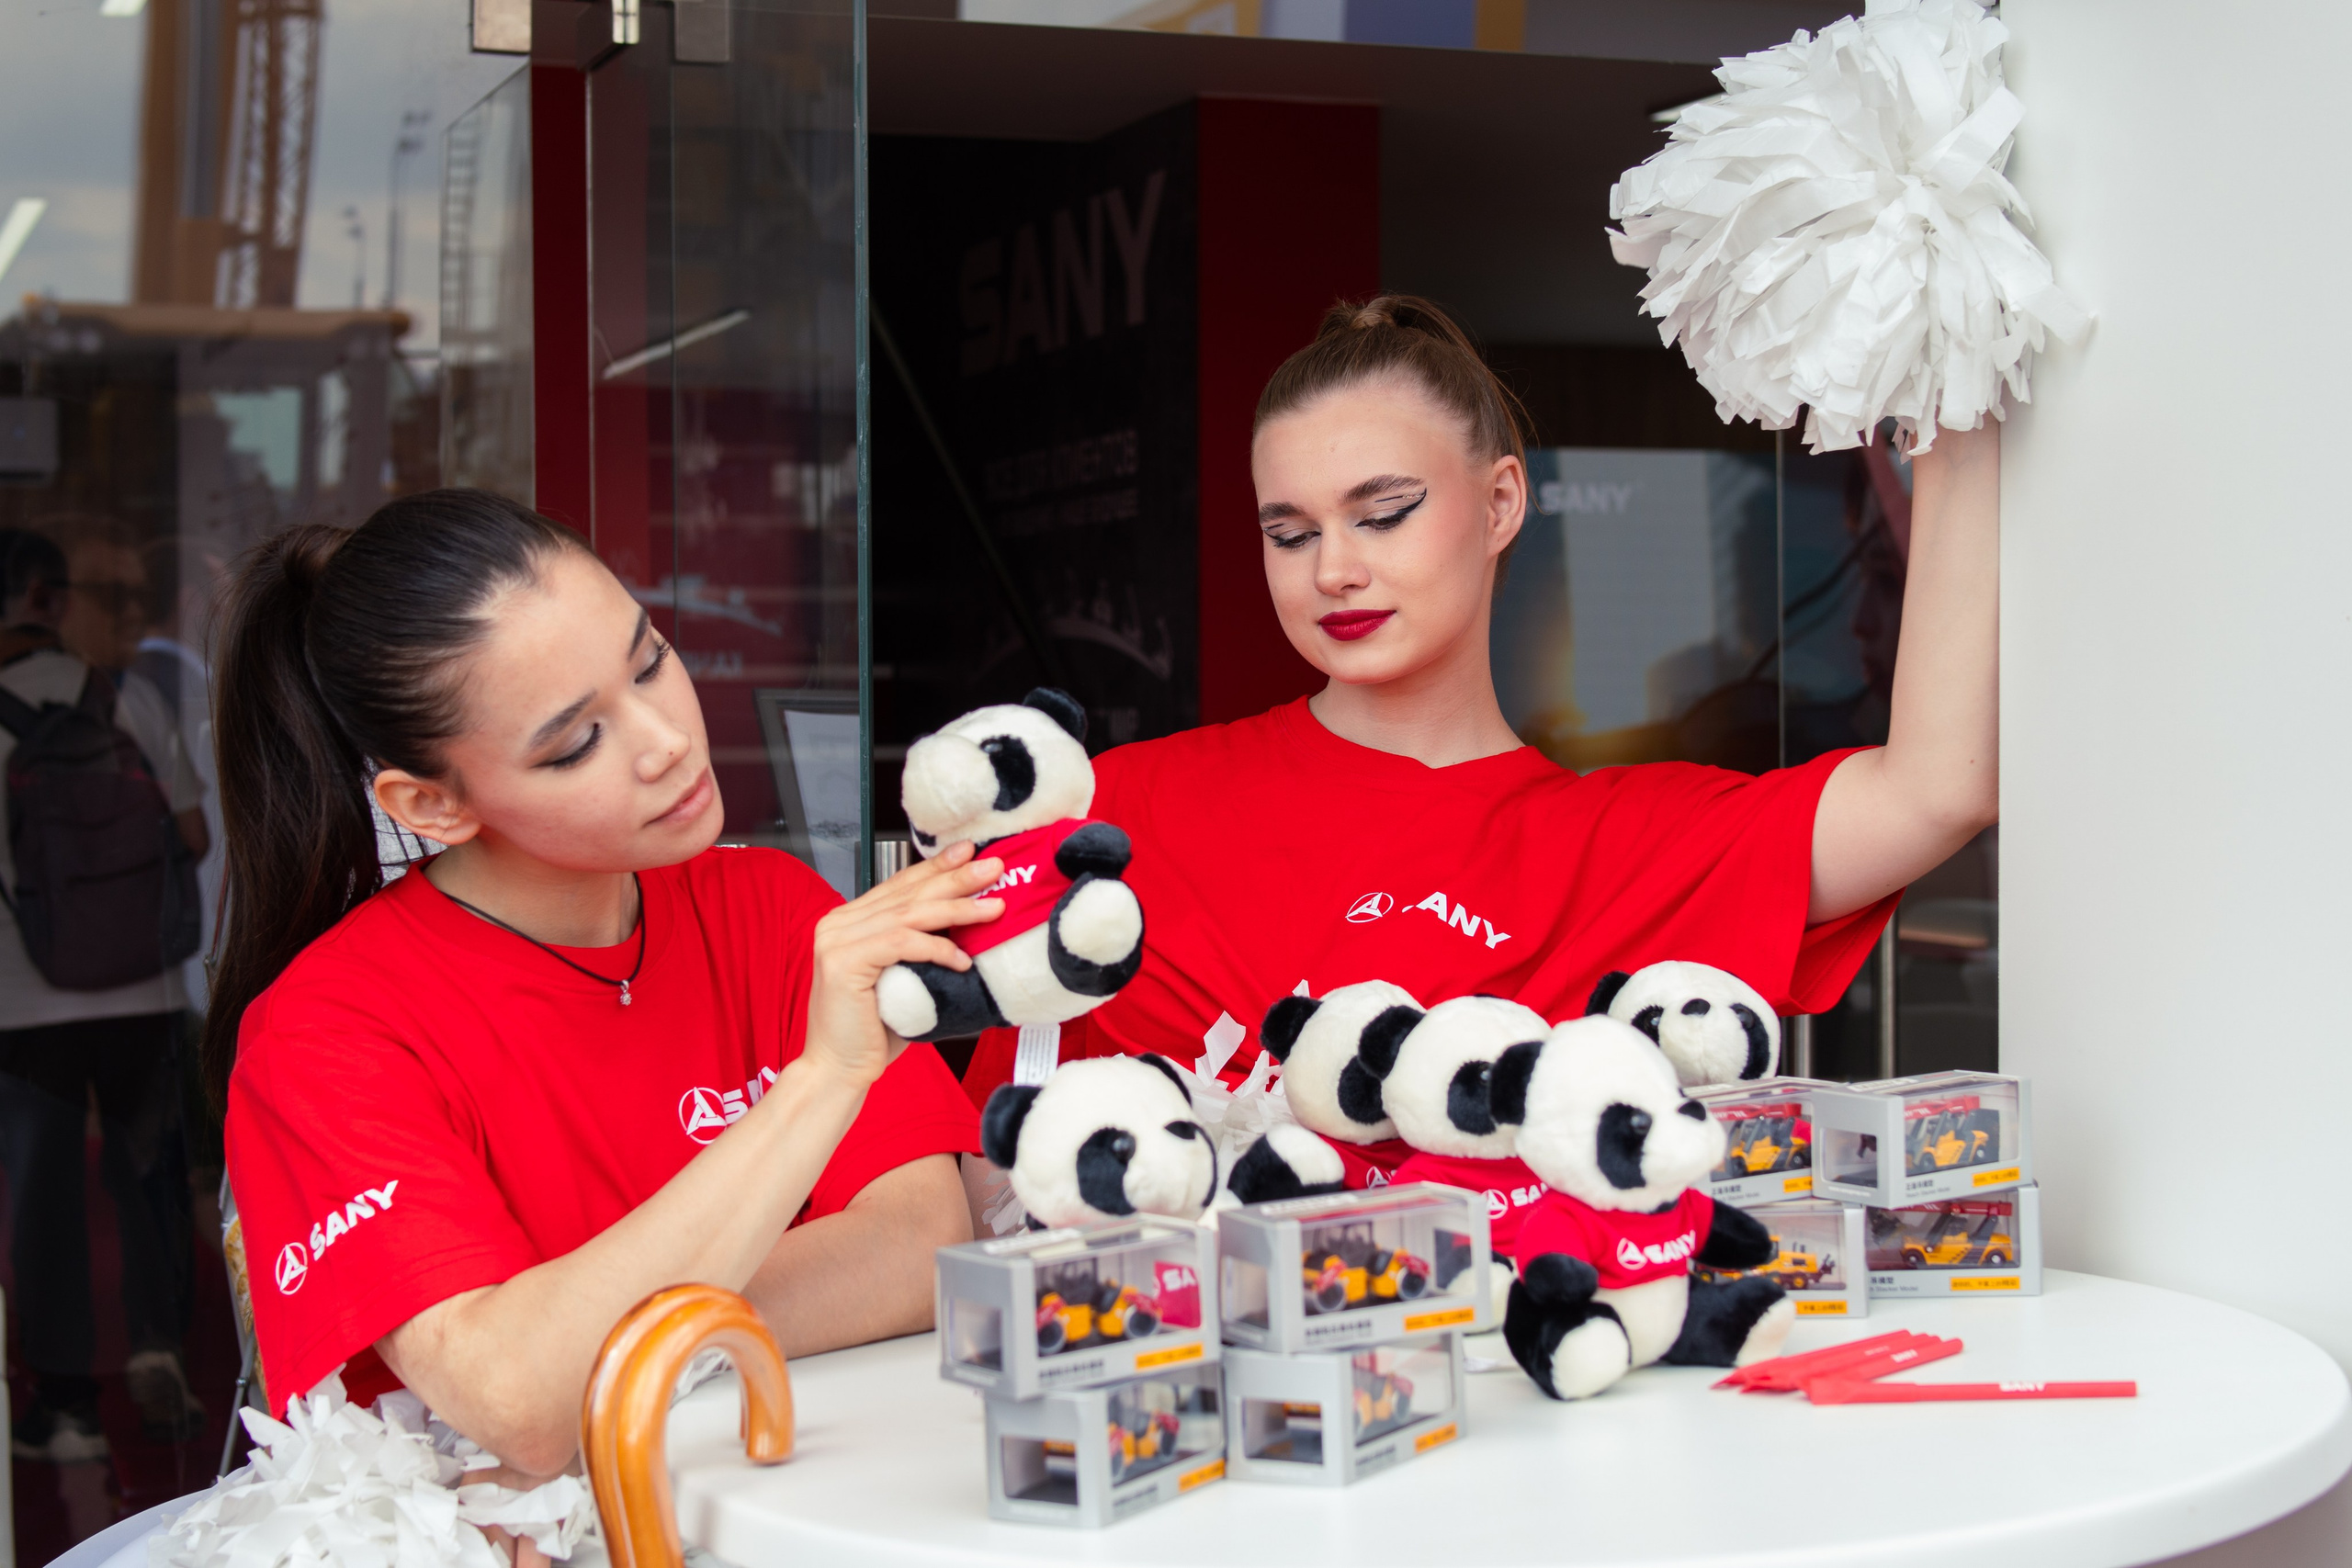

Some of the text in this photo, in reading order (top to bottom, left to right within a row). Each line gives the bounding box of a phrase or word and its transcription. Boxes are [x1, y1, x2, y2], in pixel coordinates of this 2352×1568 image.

[960, 169, 1166, 377] SANY
[1540, 482, 1632, 513] SANY
[970, 864, 1037, 899] NY
[1402, 891, 1511, 950] ANY
[310, 1179, 399, 1261] SANY
[1644, 1230, 1696, 1264] SANY
